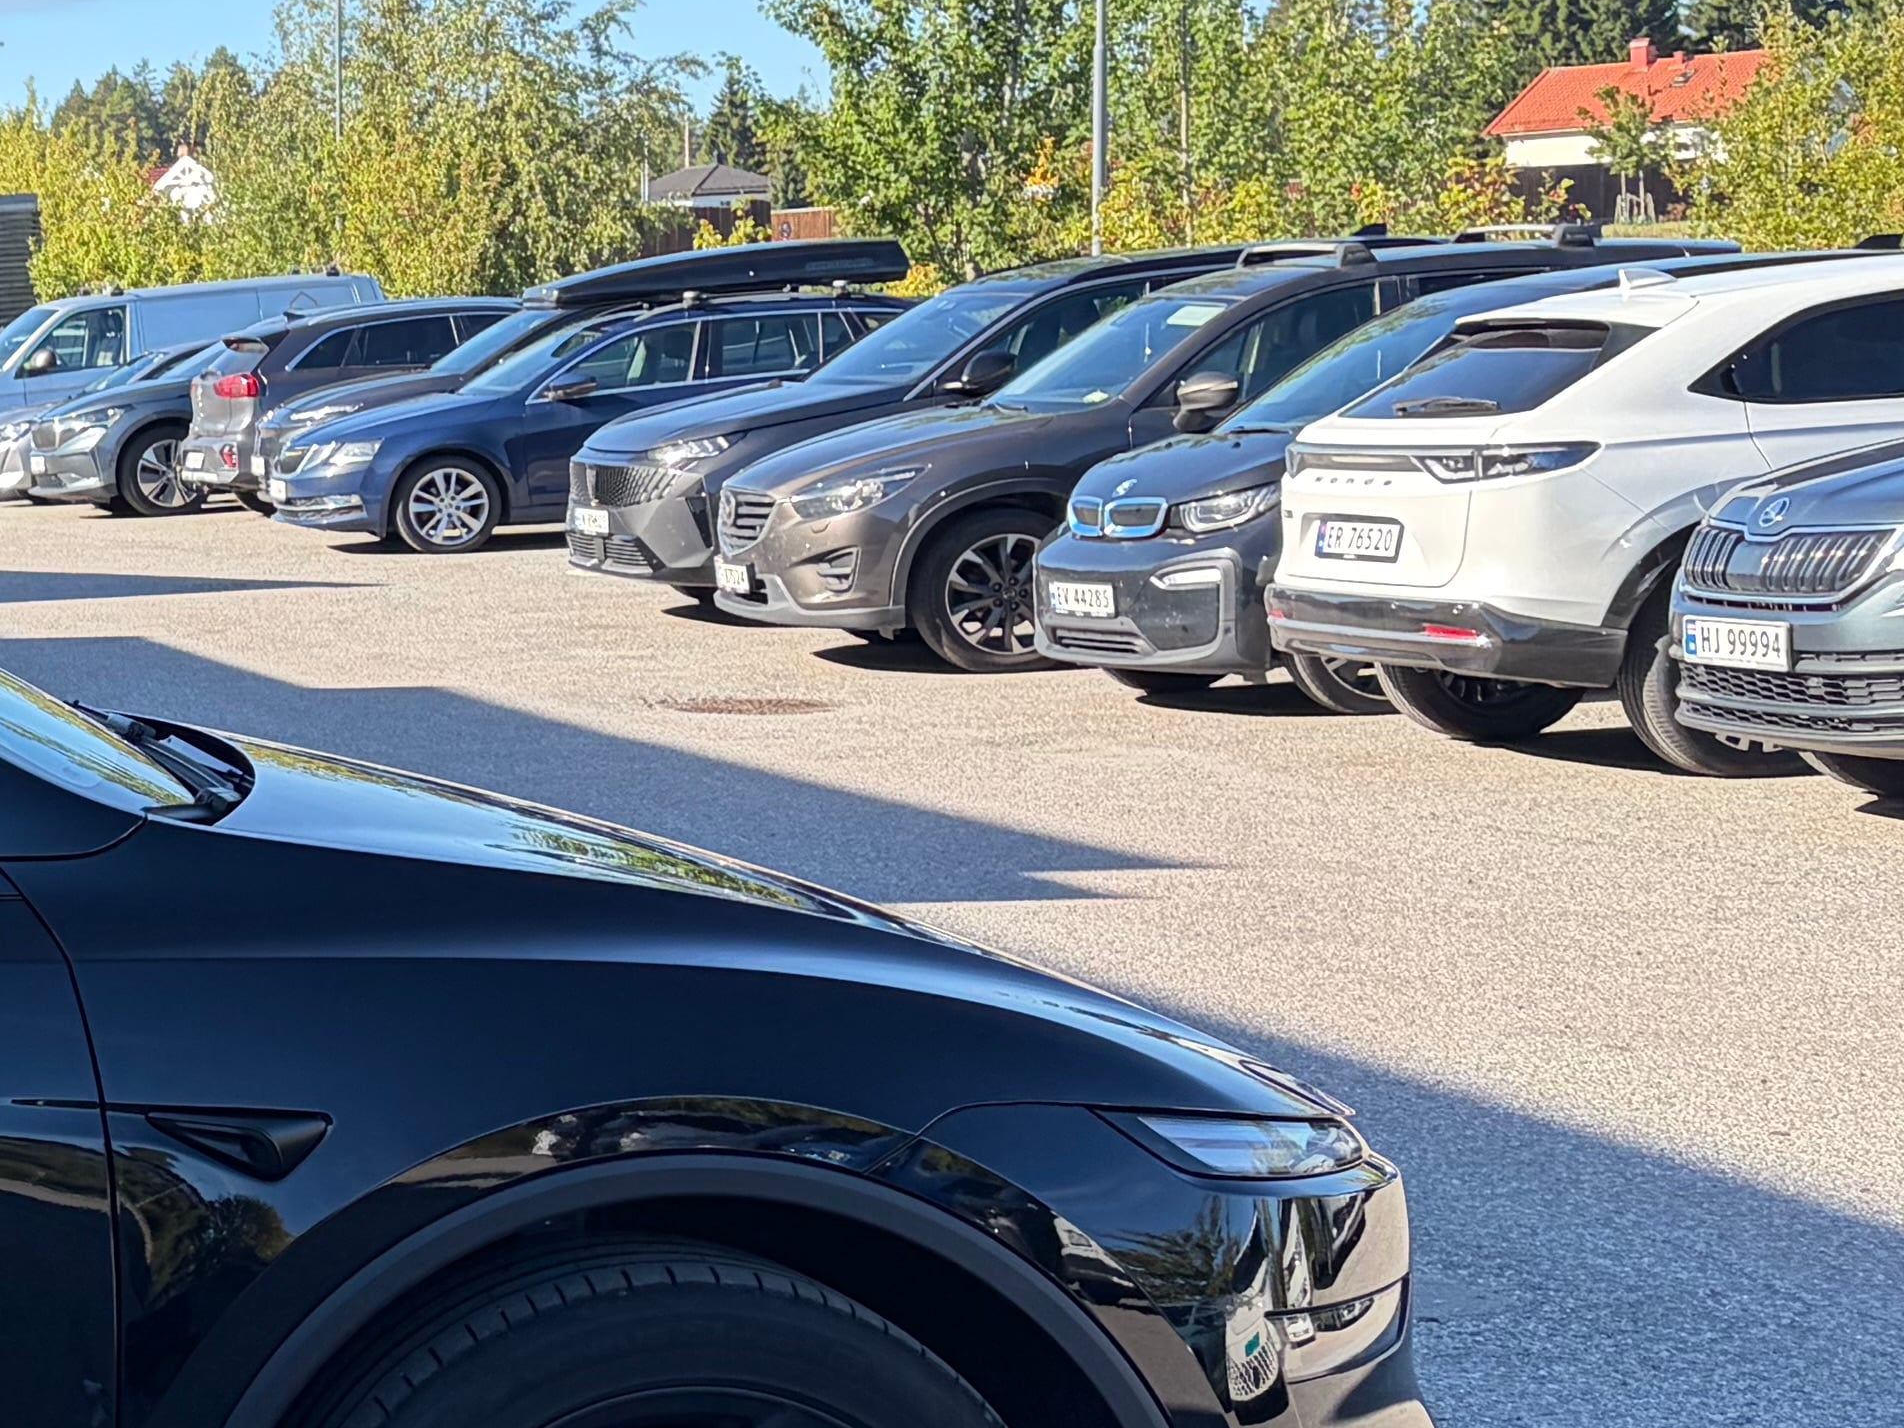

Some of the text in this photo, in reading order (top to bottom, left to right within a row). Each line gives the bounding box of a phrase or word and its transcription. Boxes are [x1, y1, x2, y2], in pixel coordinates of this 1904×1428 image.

[1327, 526, 1393, 552] ER 76520
[1057, 586, 1109, 608] EV 44285
[1701, 626, 1781, 658] HJ 99994
